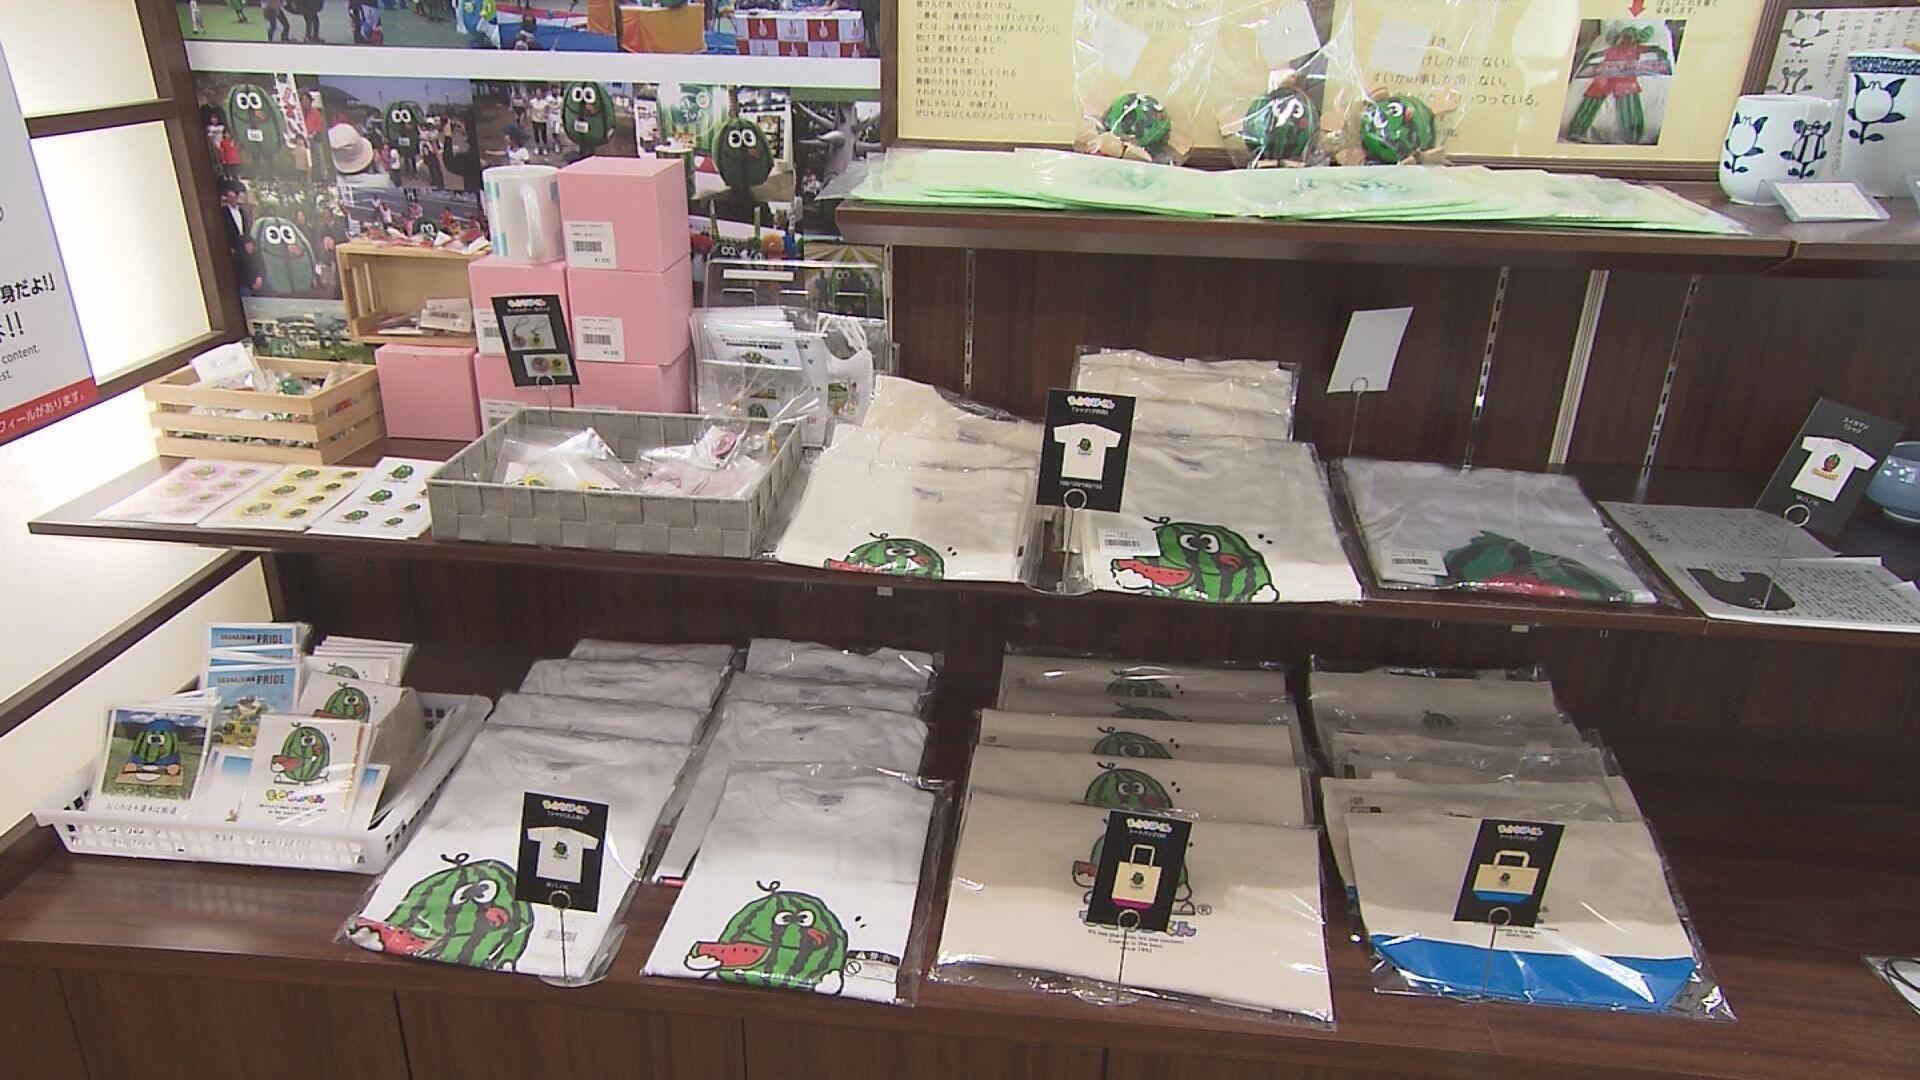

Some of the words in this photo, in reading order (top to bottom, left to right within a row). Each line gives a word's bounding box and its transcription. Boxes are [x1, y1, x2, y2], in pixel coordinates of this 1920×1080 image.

[2, 346, 41, 365] content.
[256, 632, 284, 645] PRIDE
[256, 674, 285, 685] PRIDE
